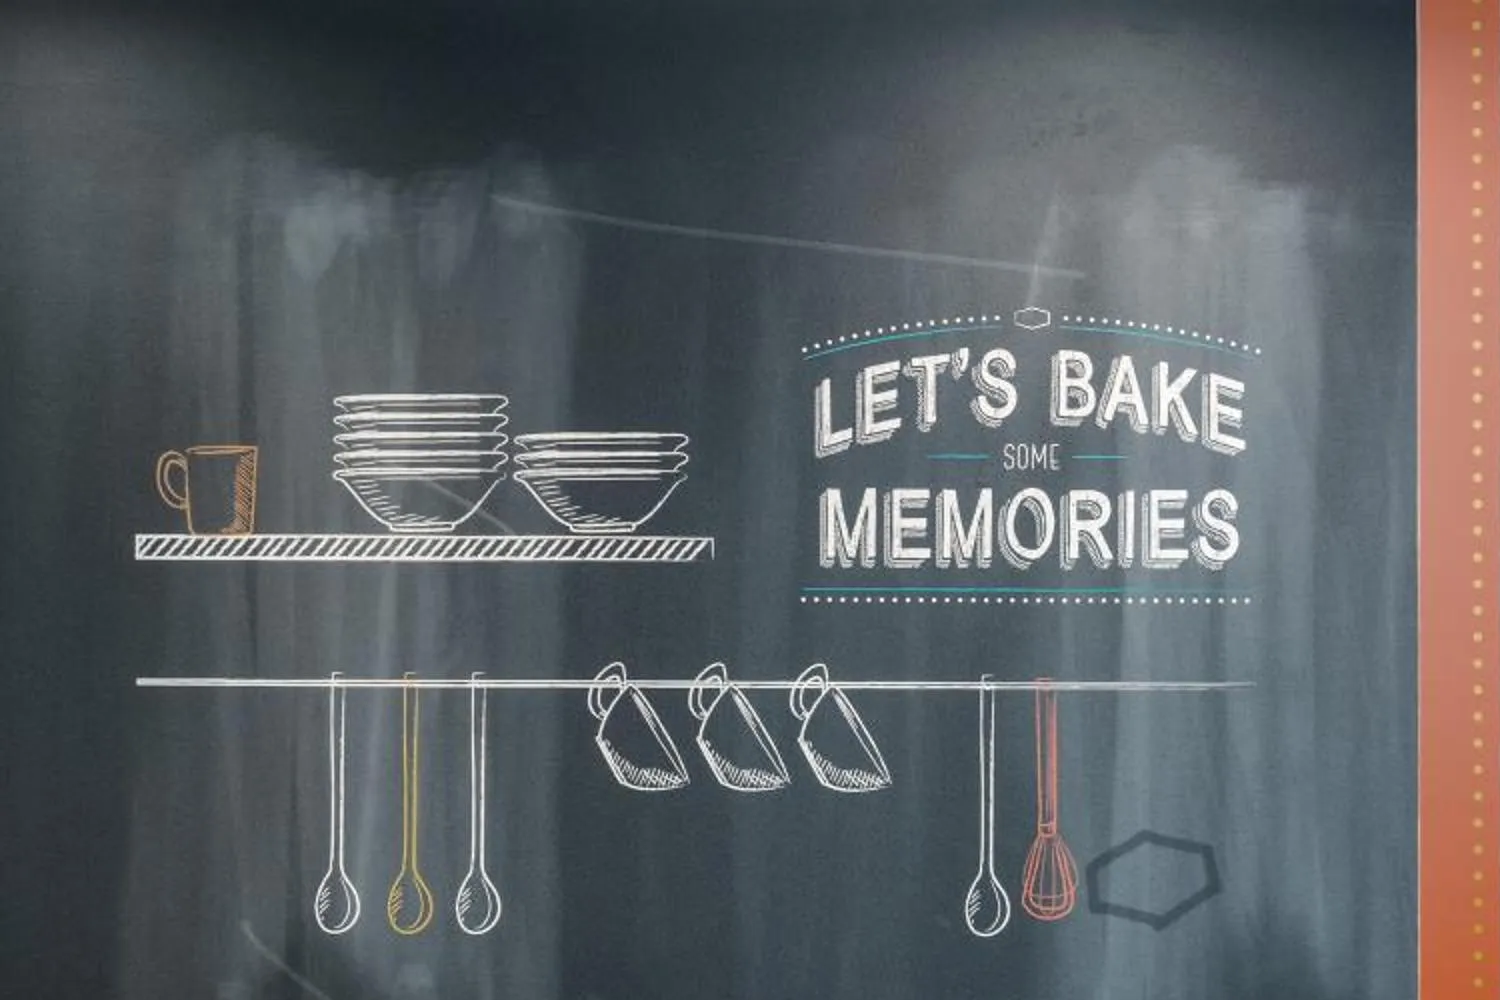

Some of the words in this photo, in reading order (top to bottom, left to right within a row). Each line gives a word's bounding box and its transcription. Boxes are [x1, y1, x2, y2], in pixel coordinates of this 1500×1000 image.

[814, 347, 1018, 459] LET'S
[1050, 349, 1247, 457] BAKE
[1002, 442, 1061, 473] SOME
[818, 487, 1241, 571] MEMORIES
